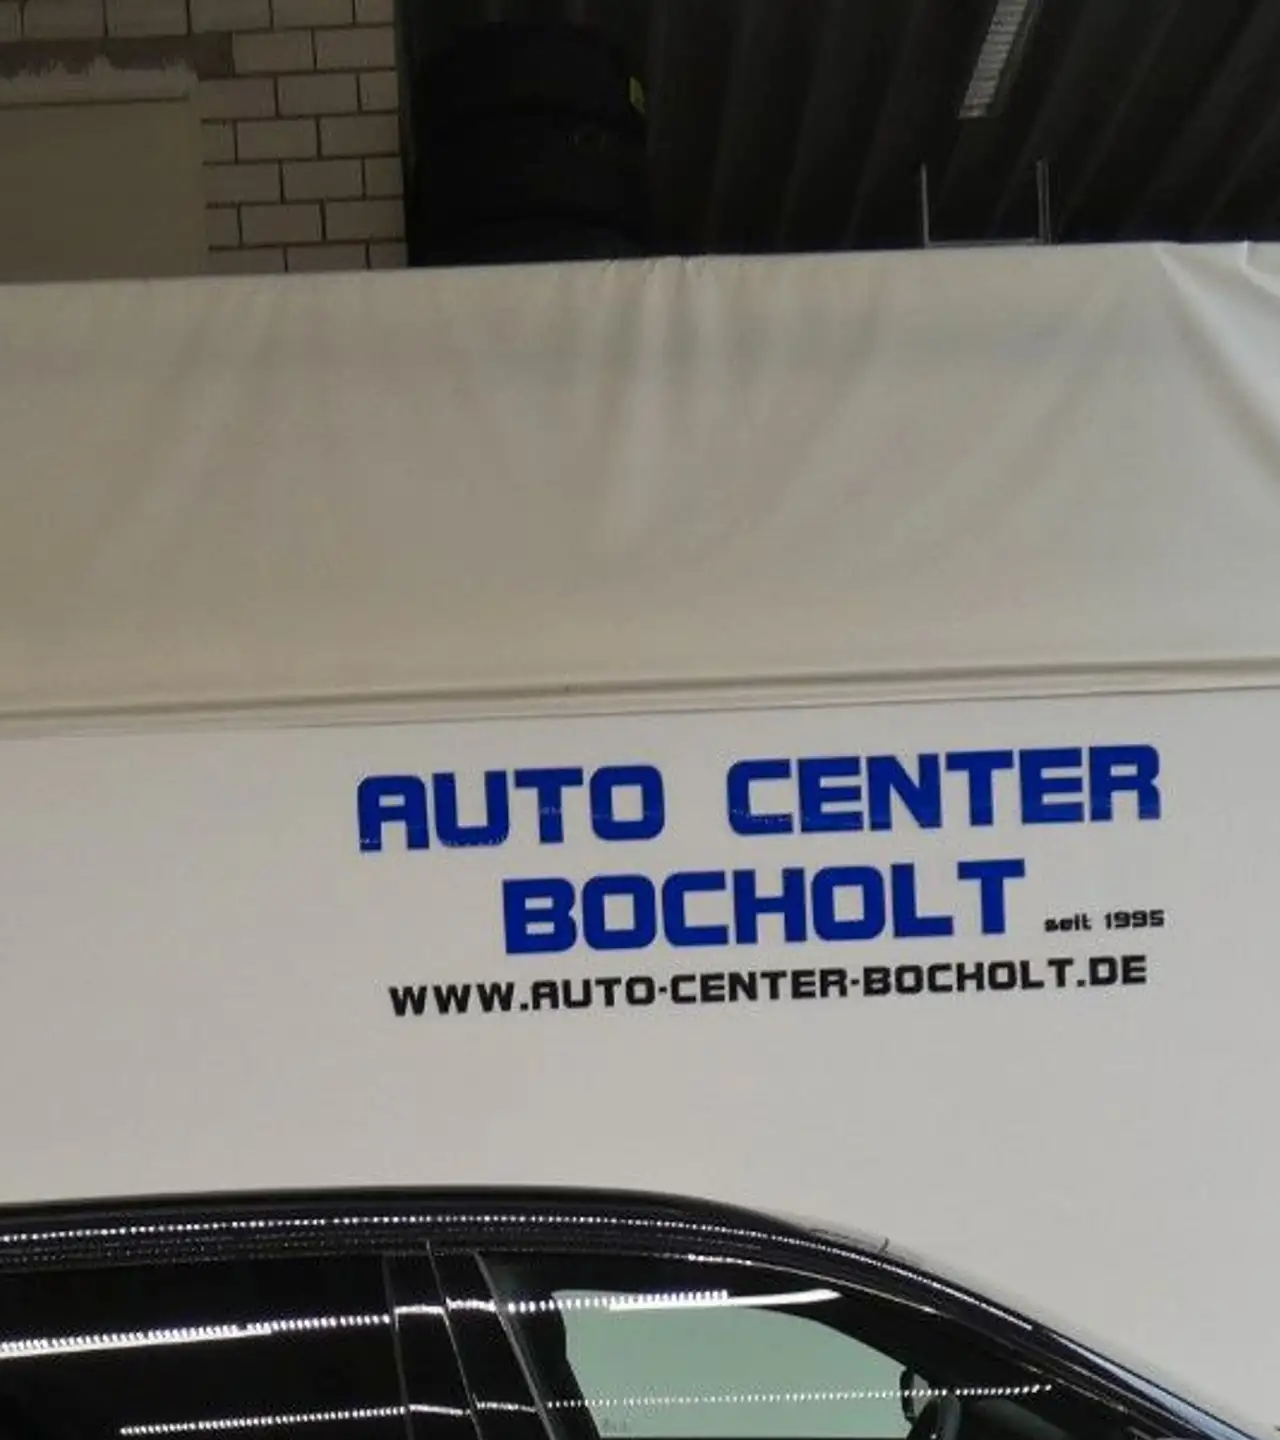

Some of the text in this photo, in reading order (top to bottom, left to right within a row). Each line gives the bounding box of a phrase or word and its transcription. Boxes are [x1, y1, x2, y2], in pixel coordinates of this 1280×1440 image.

[356, 744, 1161, 853] AUTO CENTER
[501, 858, 1165, 955] BOCHOLT seit 1995
[388, 954, 1147, 1017] WWW.AUTO-CENTER-BOCHOLT.DE
